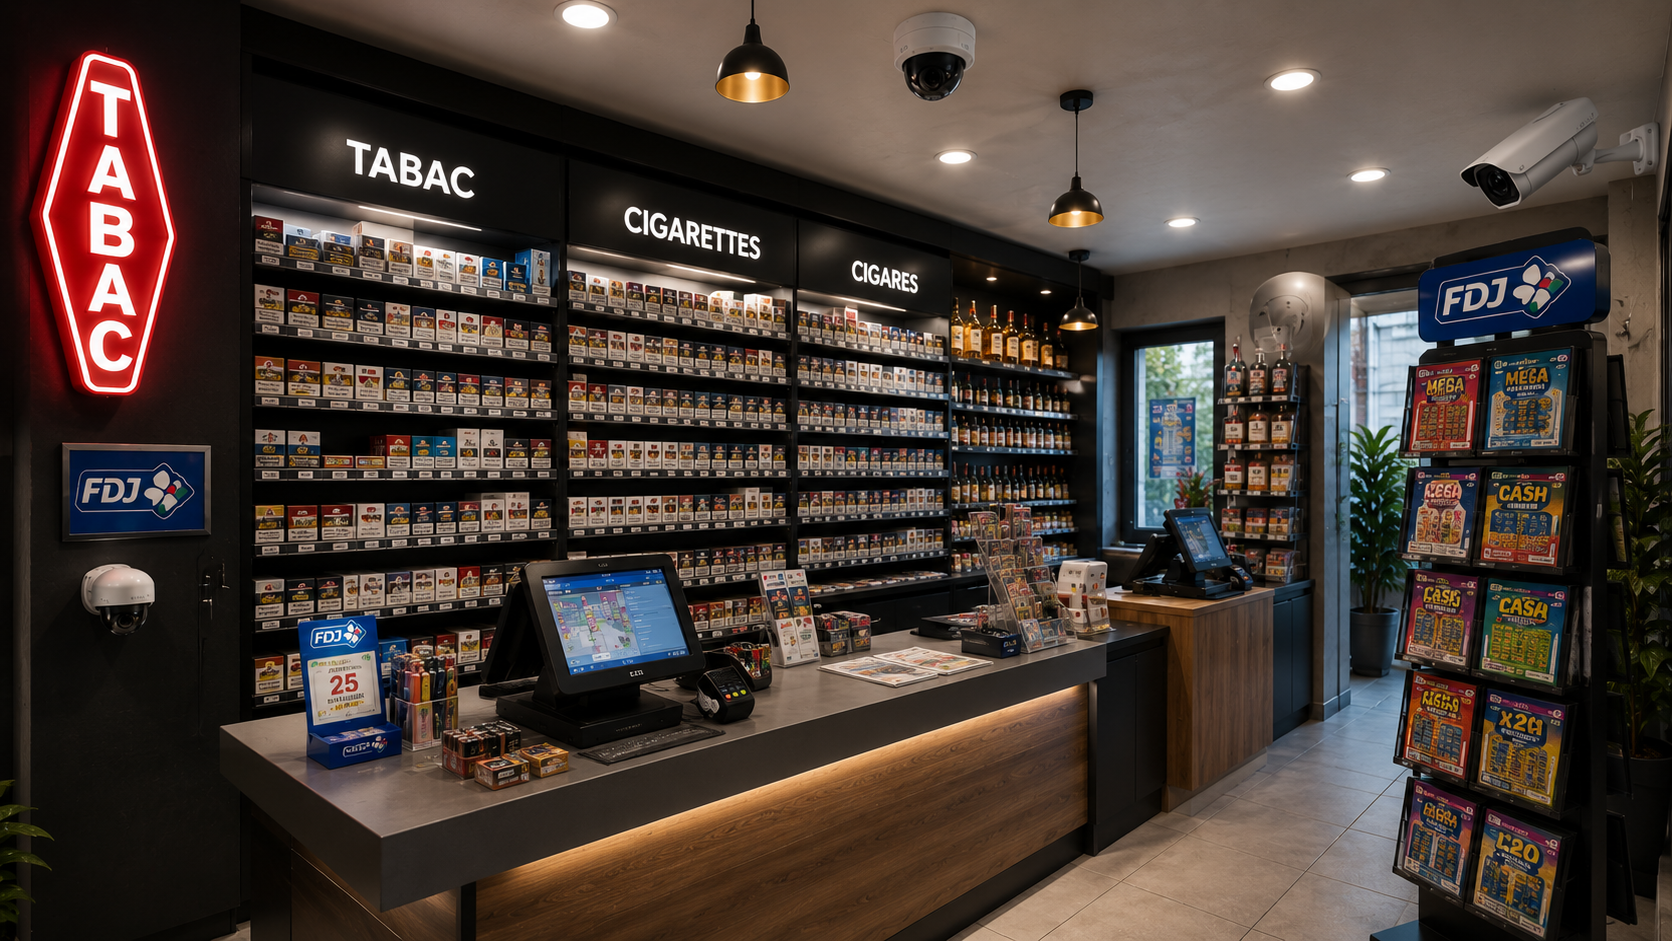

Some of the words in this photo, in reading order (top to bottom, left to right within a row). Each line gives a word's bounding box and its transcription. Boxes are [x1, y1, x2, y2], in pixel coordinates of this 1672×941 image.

[346, 138, 475, 199] TABAC
[89, 81, 136, 373] TABAC
[623, 206, 761, 260] CIGARETTES
[851, 260, 919, 294] CIGARES
[1442, 276, 1508, 316] FDJ
[1505, 367, 1549, 386] MEGA
[81, 477, 141, 503] FDJ
[1498, 484, 1548, 502] CASH
[1499, 597, 1548, 618] CASH
[314, 629, 342, 644] FDJ
[329, 672, 359, 696] 25
